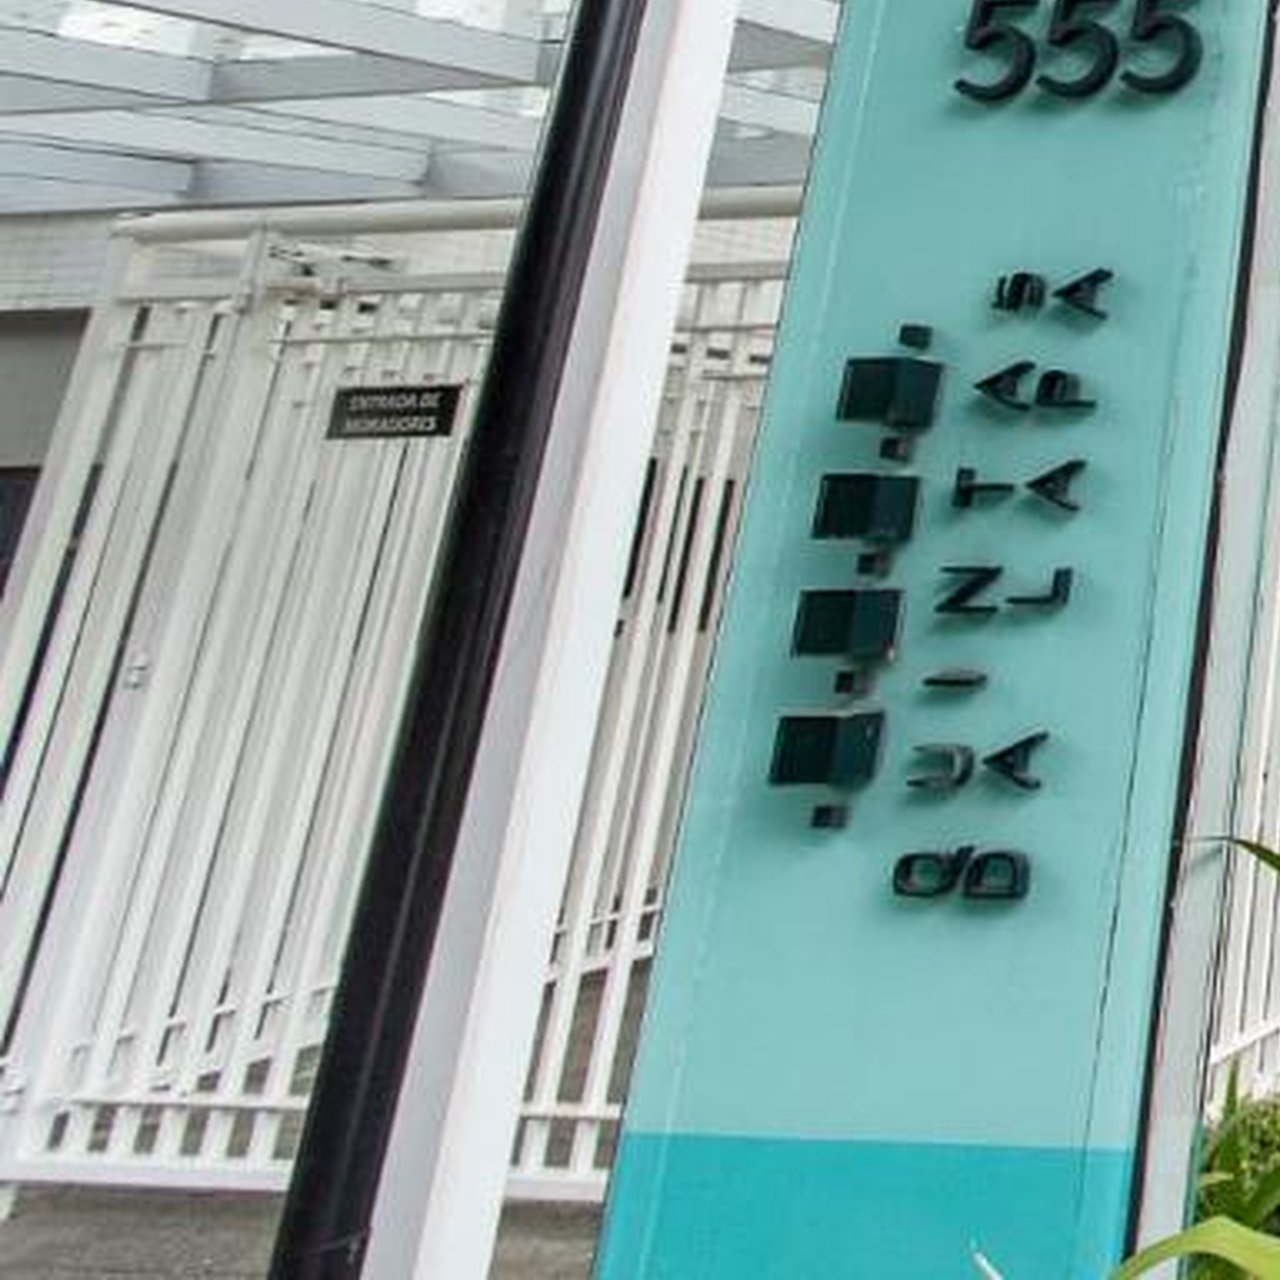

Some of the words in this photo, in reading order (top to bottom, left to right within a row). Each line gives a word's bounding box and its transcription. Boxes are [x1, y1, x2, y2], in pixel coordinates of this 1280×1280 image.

[892, 270, 1046, 898] QUINTAS
[1005, 267, 1114, 614] LAPA
[963, 730, 1050, 899] DA
